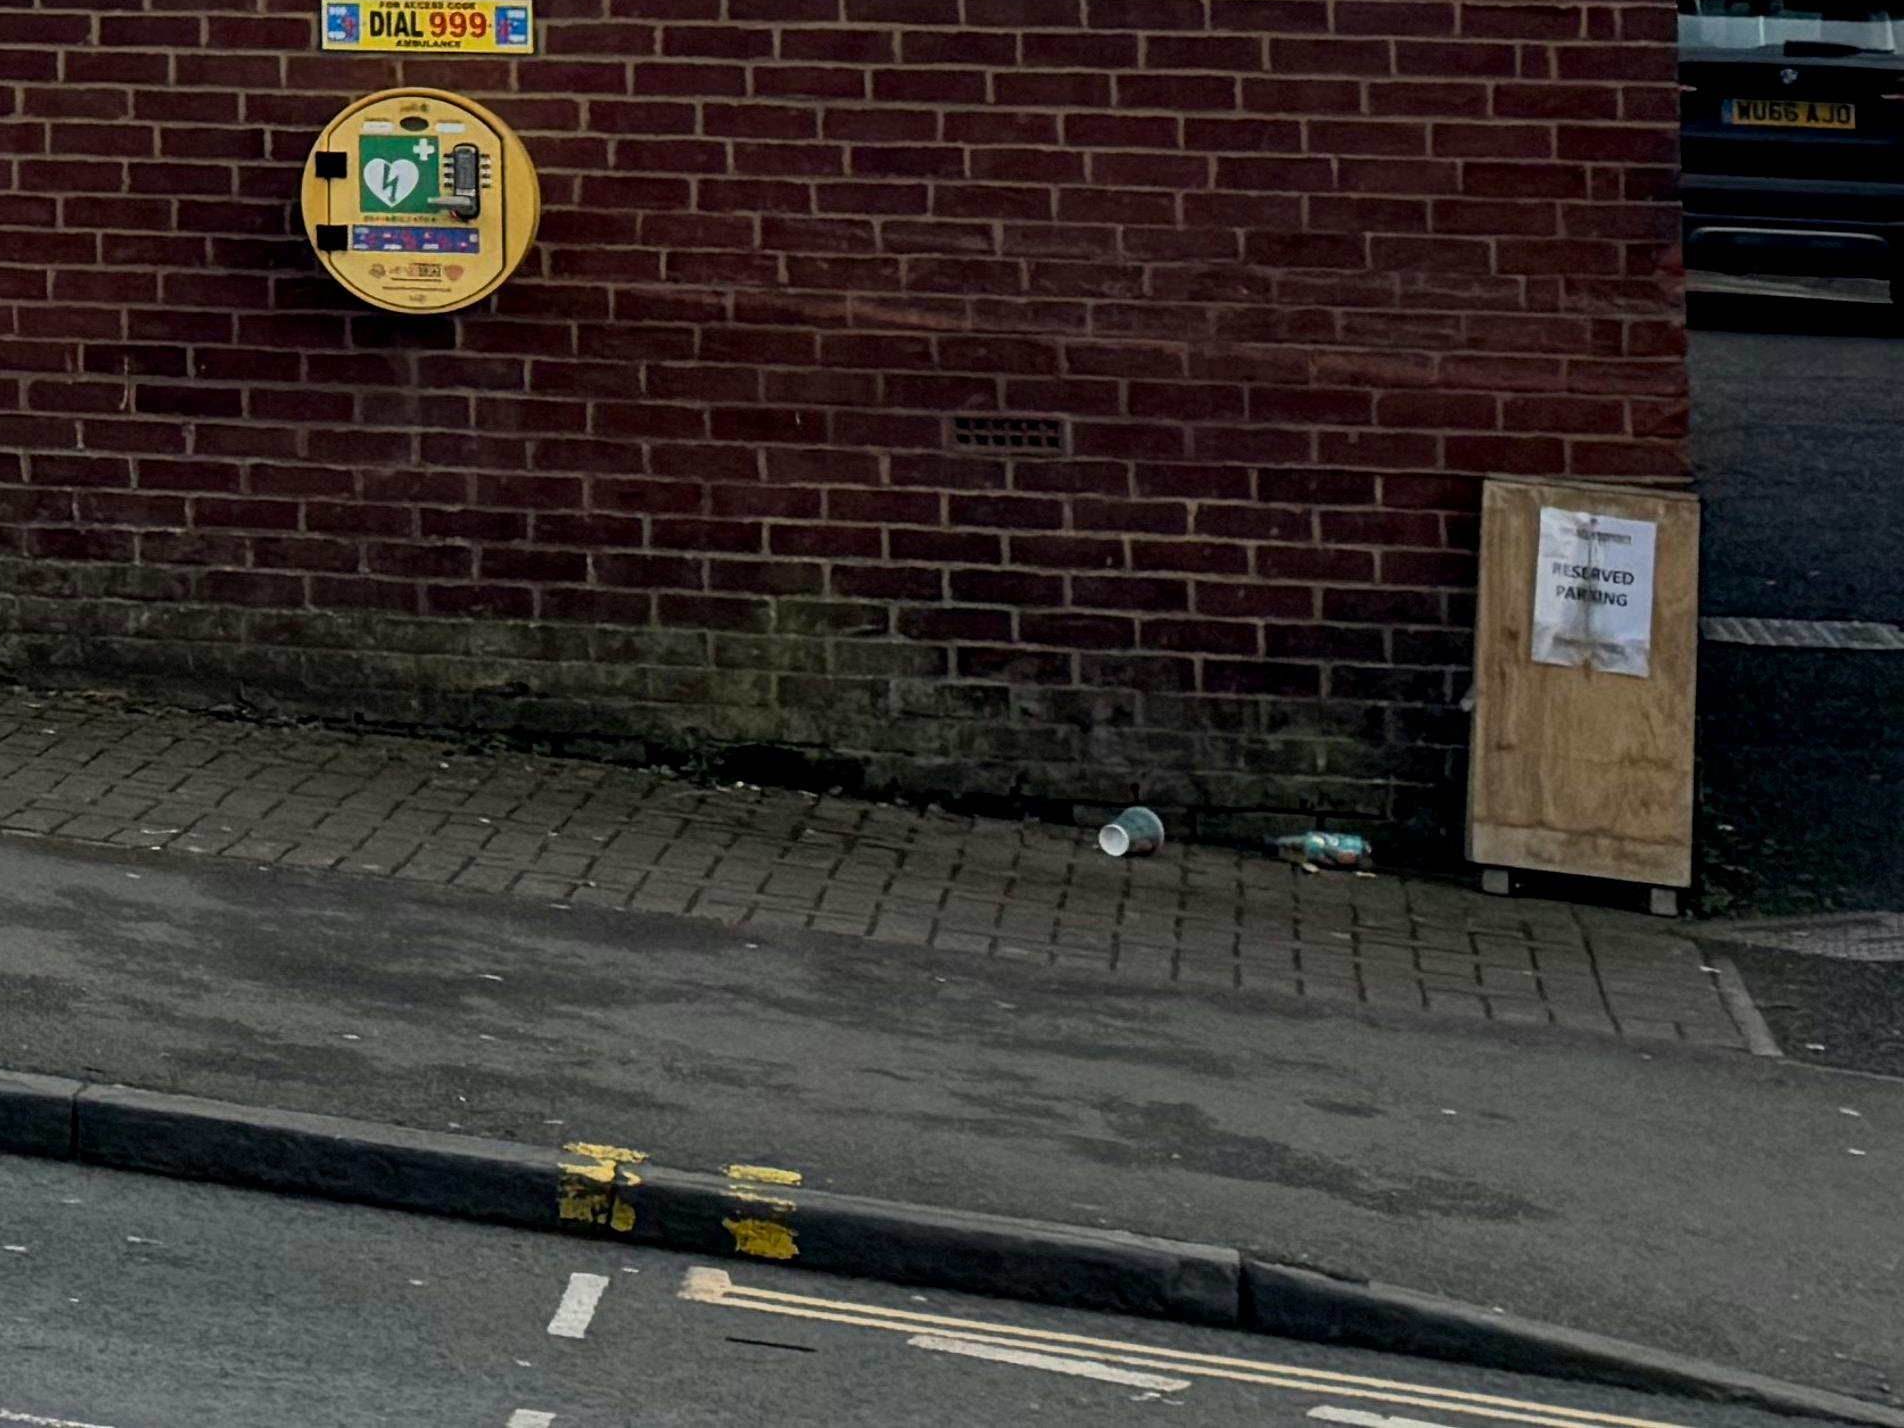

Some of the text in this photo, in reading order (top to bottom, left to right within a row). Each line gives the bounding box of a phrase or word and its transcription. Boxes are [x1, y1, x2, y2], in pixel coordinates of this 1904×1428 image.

[379, 1, 400, 10] FOR
[369, 10, 488, 39] DIAL 999
[395, 39, 462, 49] AMBULANCE
[1551, 562, 1635, 586] RESERVED
[1555, 585, 1628, 608] PARKING
